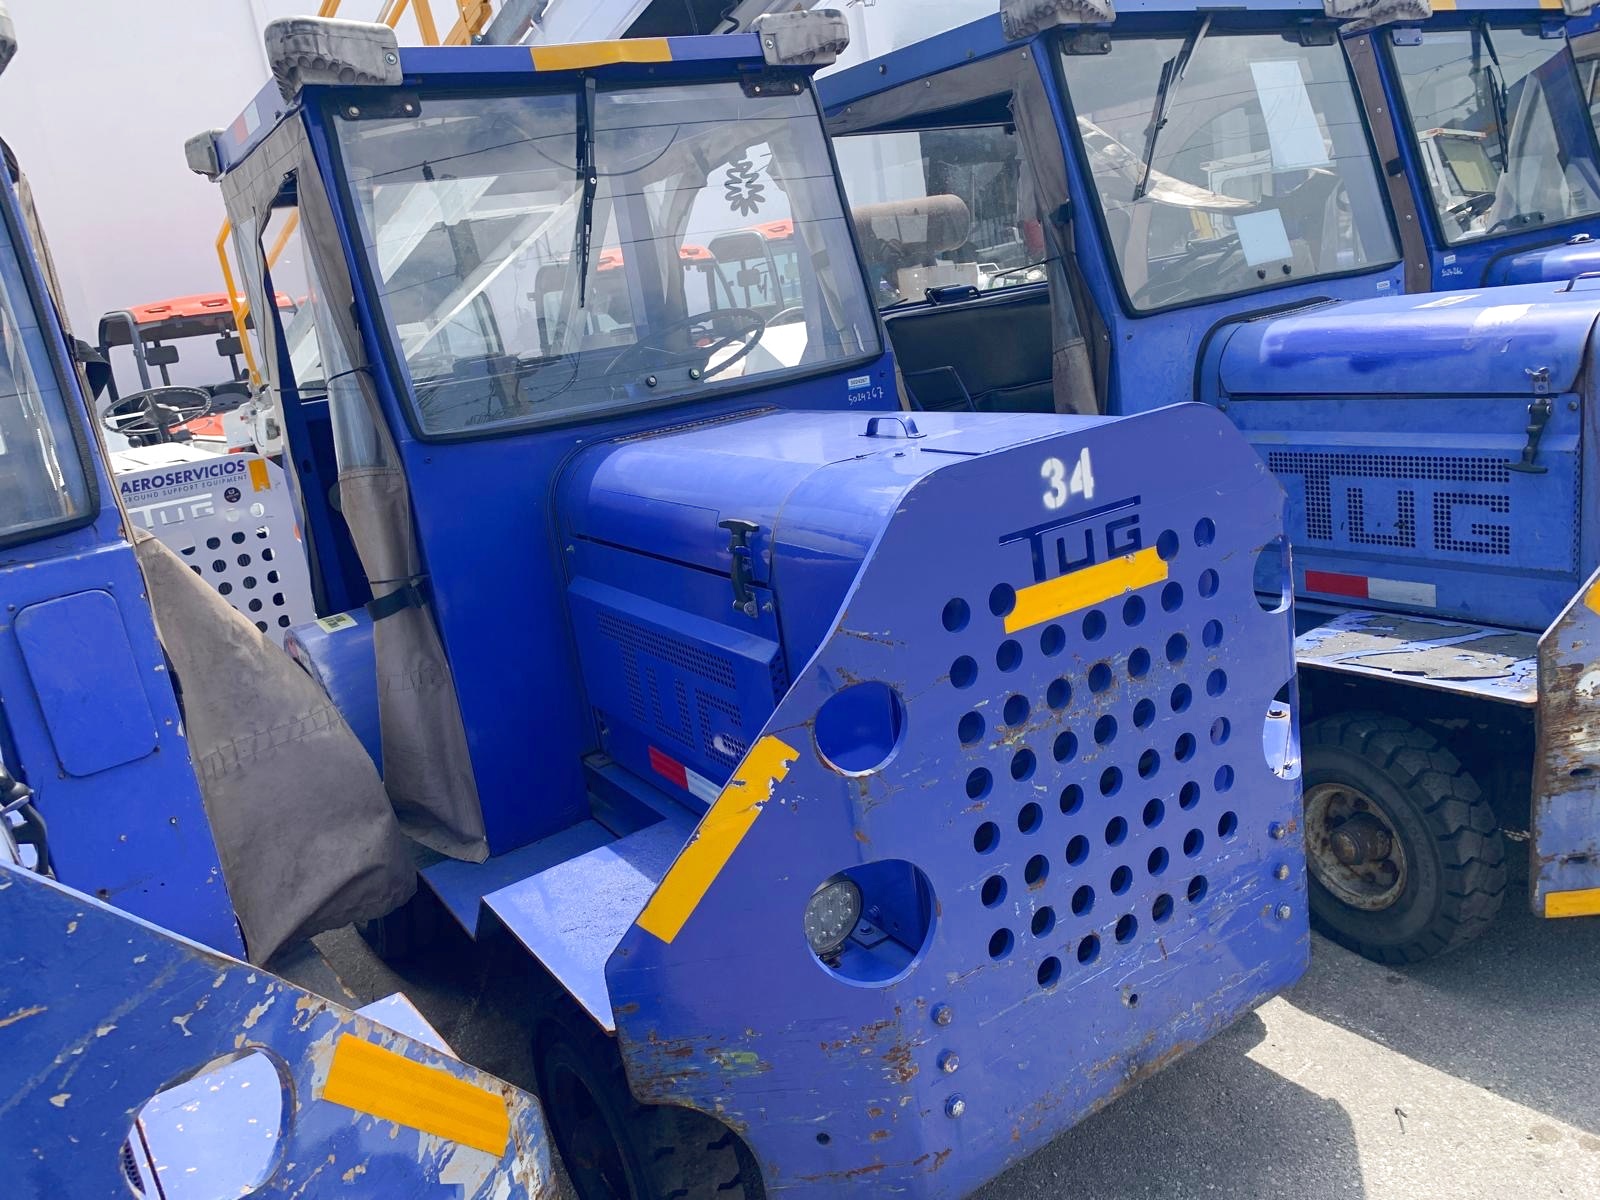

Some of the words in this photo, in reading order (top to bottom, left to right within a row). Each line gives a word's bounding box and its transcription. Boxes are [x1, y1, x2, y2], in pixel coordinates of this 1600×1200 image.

[121, 460, 246, 494] AEROSERVICIOS
[162, 484, 198, 496] SUPPORT
[201, 474, 247, 488] EQUIPMENT
[1040, 446, 1095, 510] 34
[1269, 452, 1510, 554] TUG
[128, 493, 215, 529] TUG
[999, 495, 1142, 583] TUG
[597, 612, 747, 770] TUG
